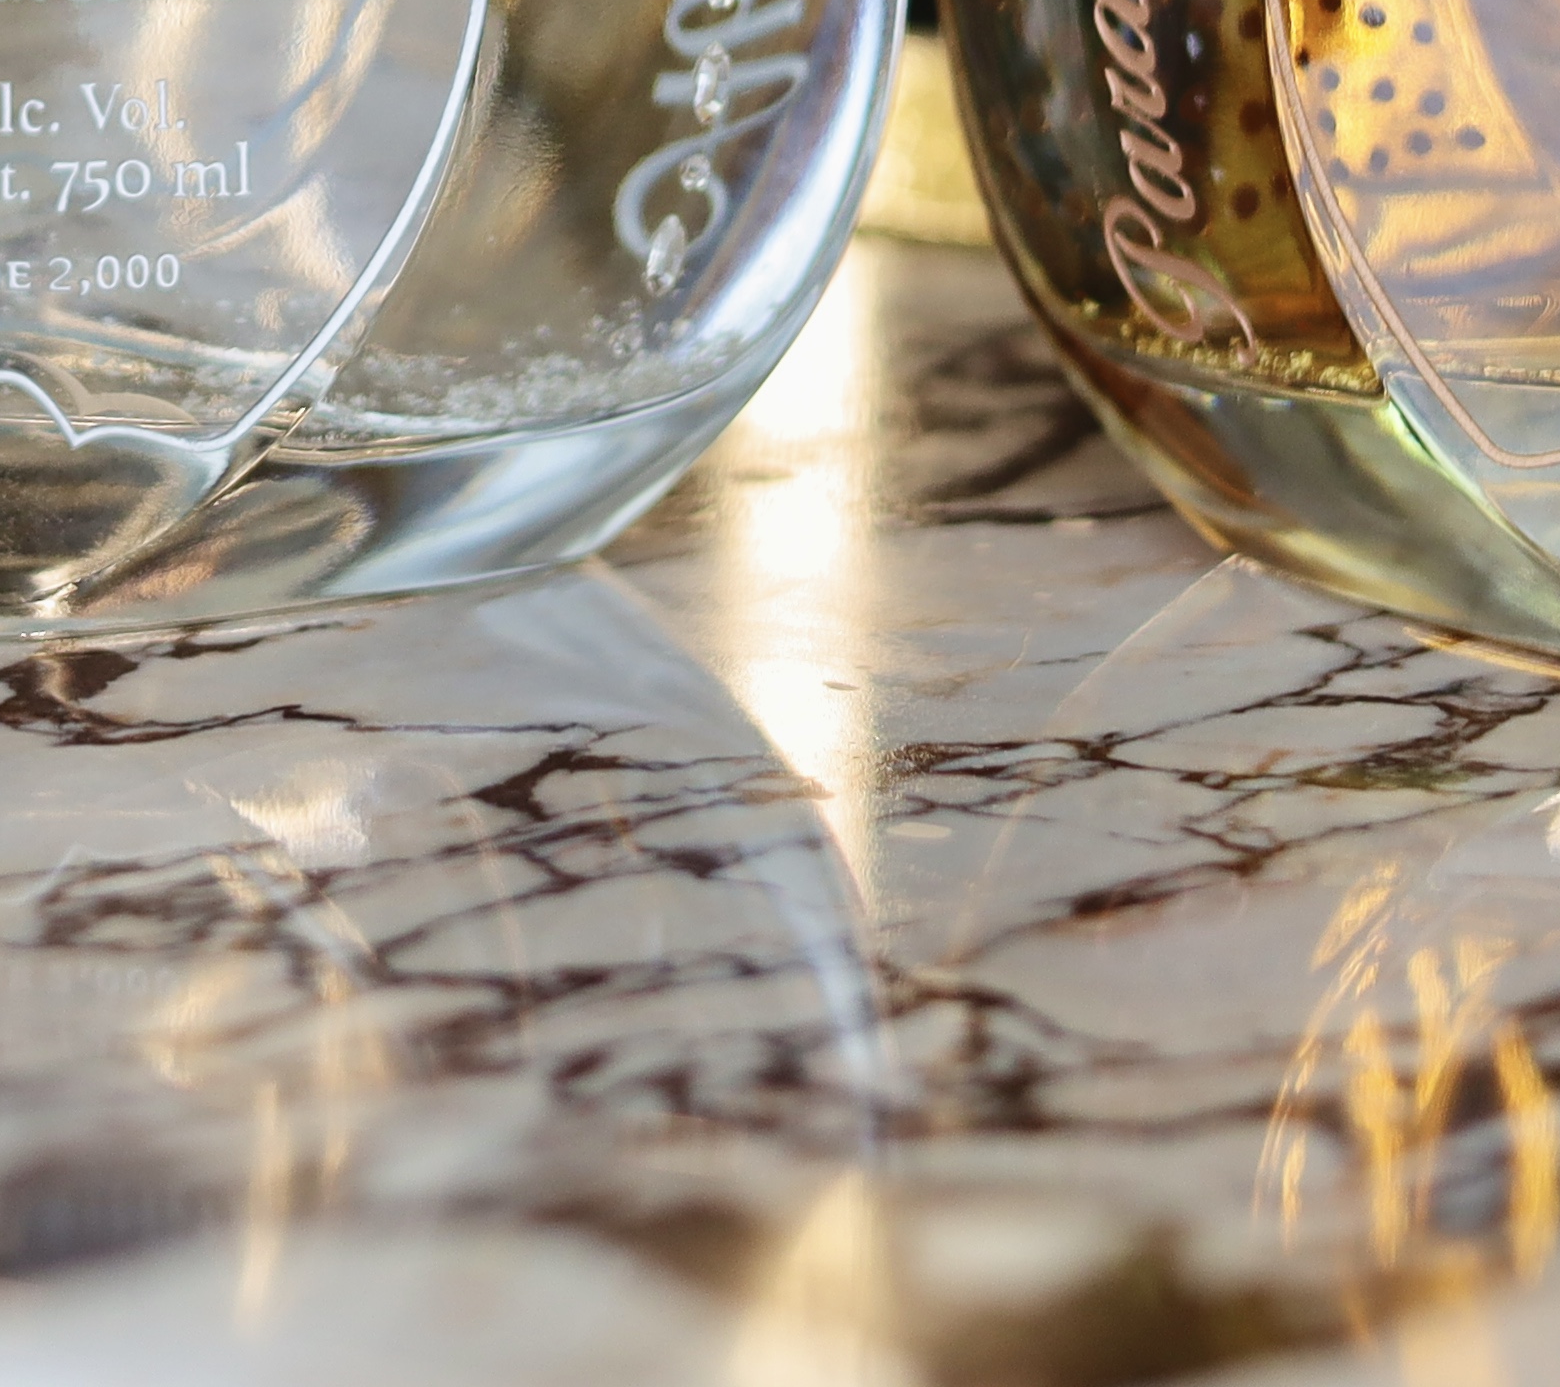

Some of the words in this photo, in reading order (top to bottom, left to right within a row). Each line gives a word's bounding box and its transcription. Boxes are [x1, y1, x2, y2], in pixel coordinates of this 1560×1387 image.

[79, 81, 188, 132] Vol.
[49, 158, 152, 213] 750
[172, 140, 251, 199] ml
[48, 252, 181, 296] 2,000
